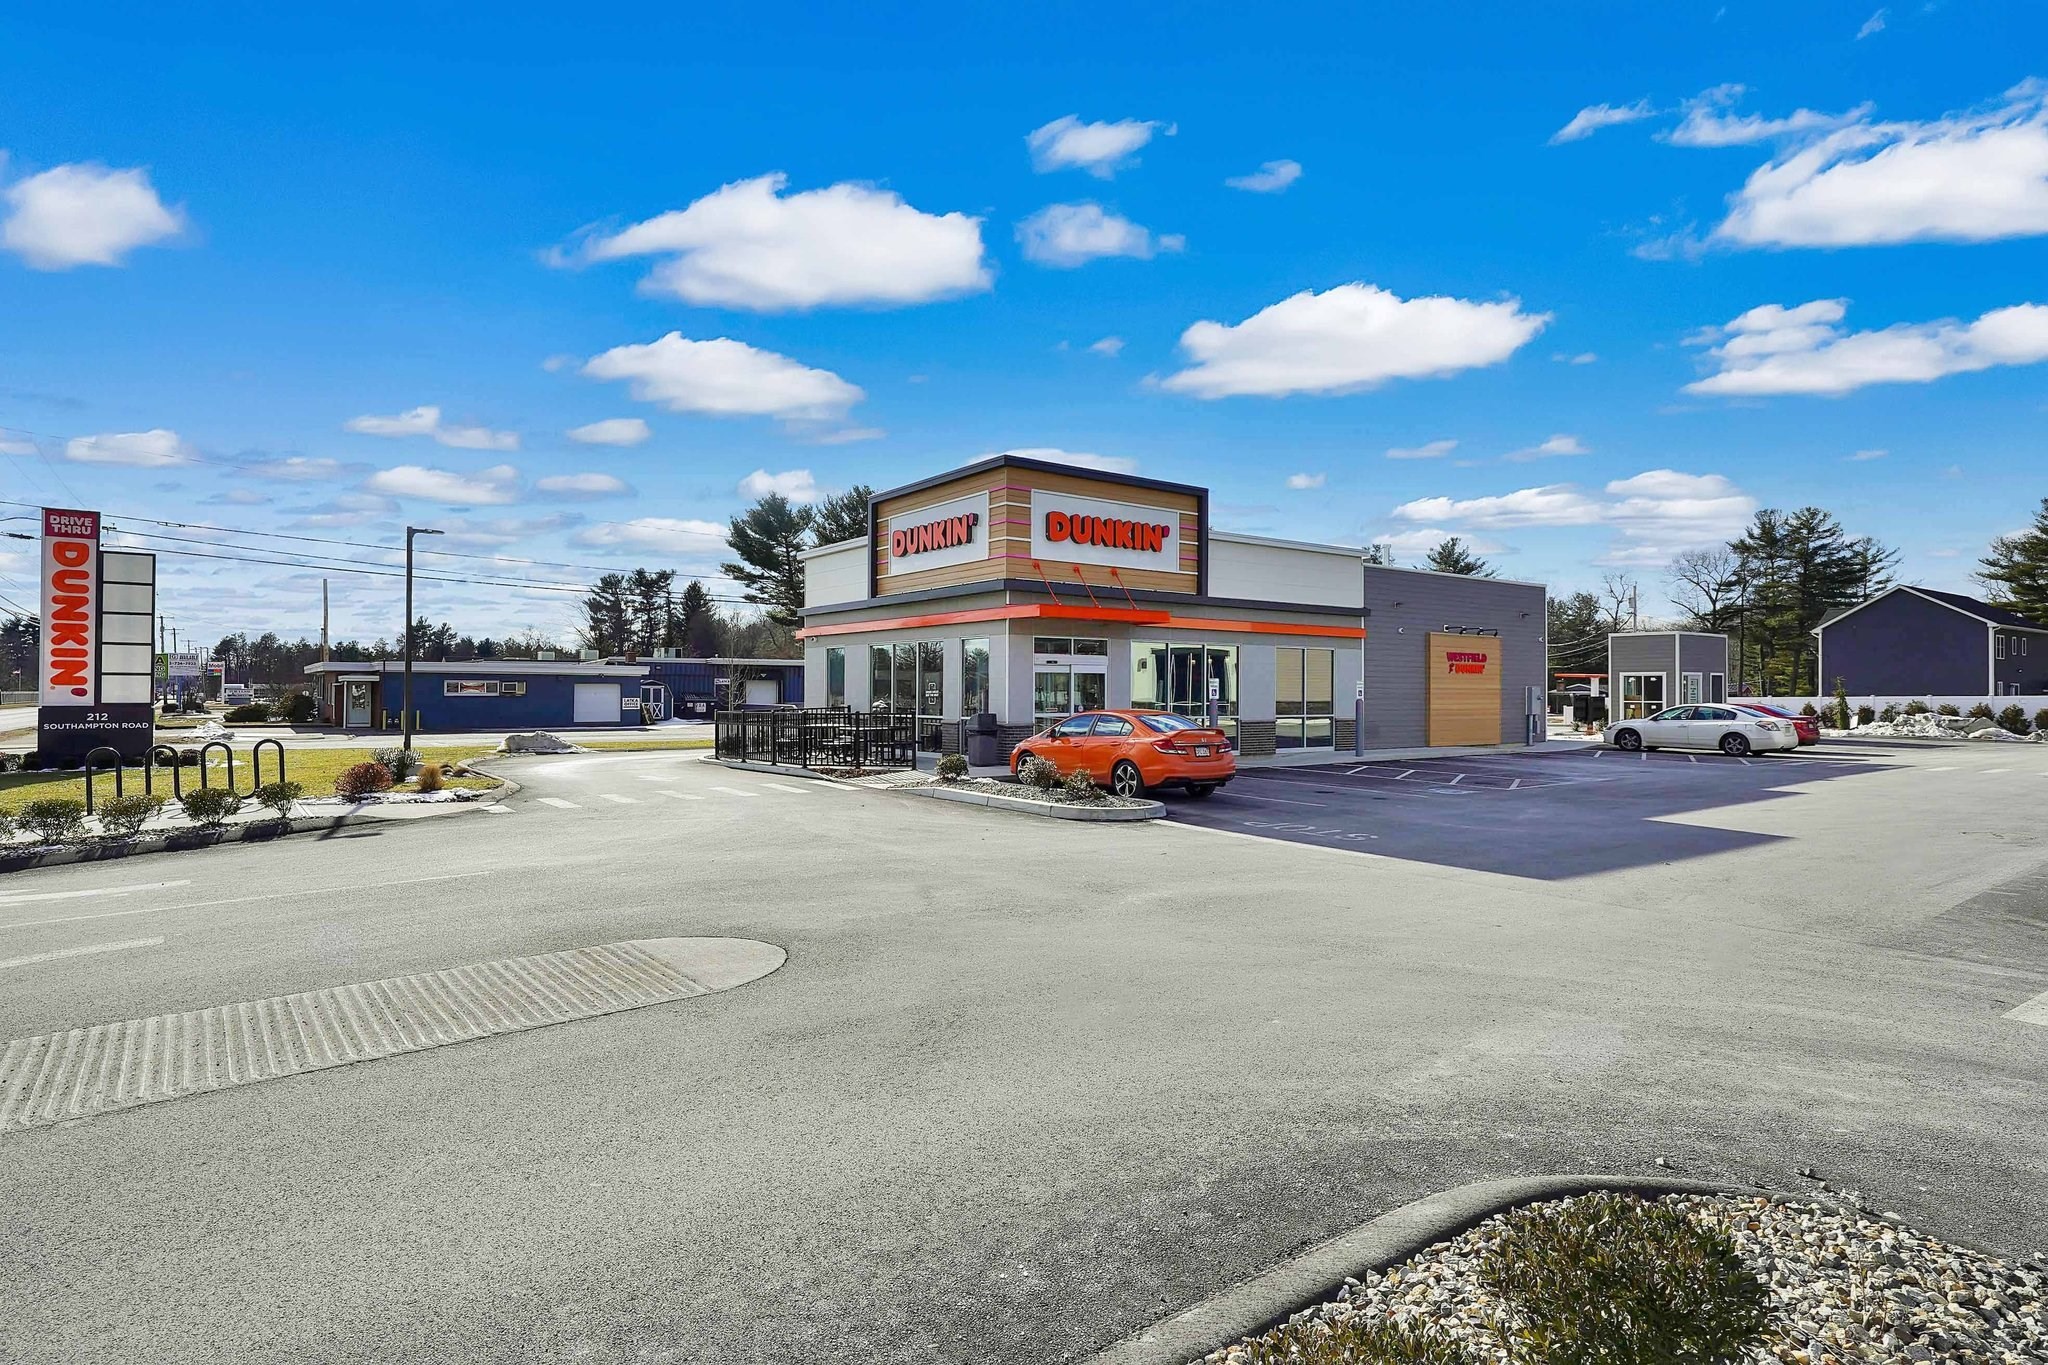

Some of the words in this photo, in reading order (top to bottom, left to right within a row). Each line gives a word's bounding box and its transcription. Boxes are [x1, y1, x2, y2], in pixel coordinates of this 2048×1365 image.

[50, 515, 93, 526] DRIVE
[51, 524, 92, 535] THRU
[892, 512, 978, 557] DUNKIN'
[1046, 510, 1170, 553] DUNKIN'
[1446, 651, 1487, 663] WESTFIELD
[86, 713, 109, 721] 212
[43, 722, 119, 730] SOUTHAMPTON
